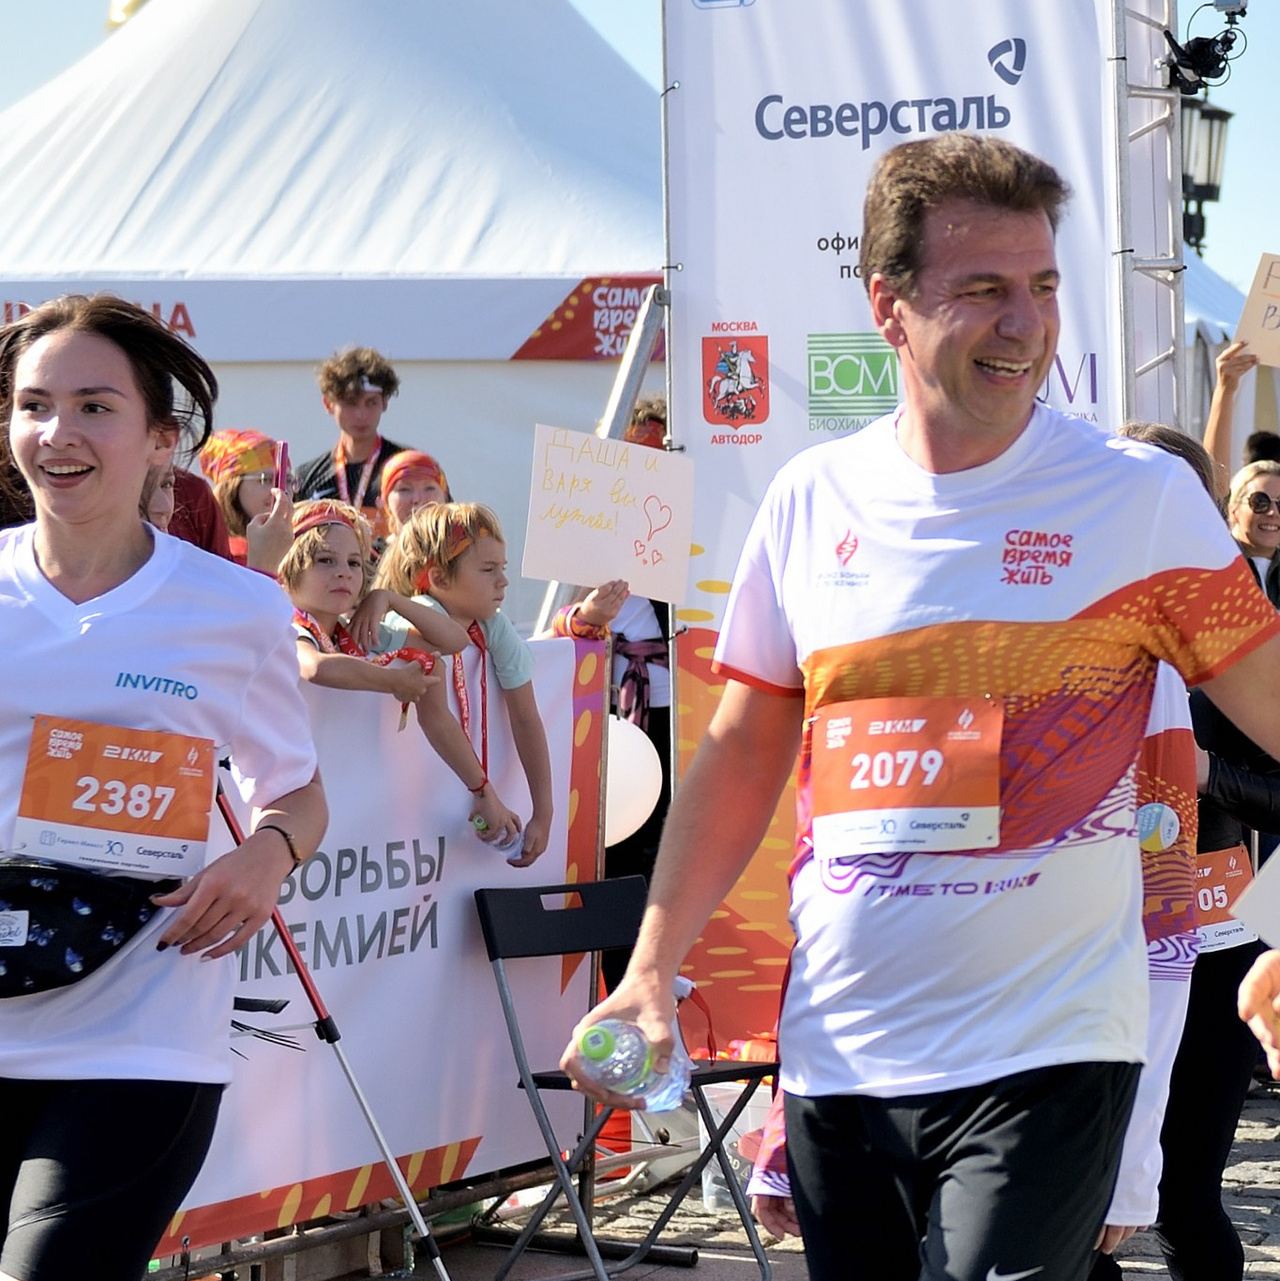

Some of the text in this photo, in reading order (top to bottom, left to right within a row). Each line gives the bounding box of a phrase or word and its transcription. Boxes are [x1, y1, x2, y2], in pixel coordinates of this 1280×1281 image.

[754, 93, 1011, 151] Северсталь
[711, 321, 758, 332] МОСКВА
[545, 429, 630, 468] ДАША
[710, 433, 763, 446] АВТОДОР
[116, 673, 198, 700] INVITRO
[850, 749, 945, 790] 2079
[72, 775, 176, 821] 2387
[940, 882, 979, 896] TO
